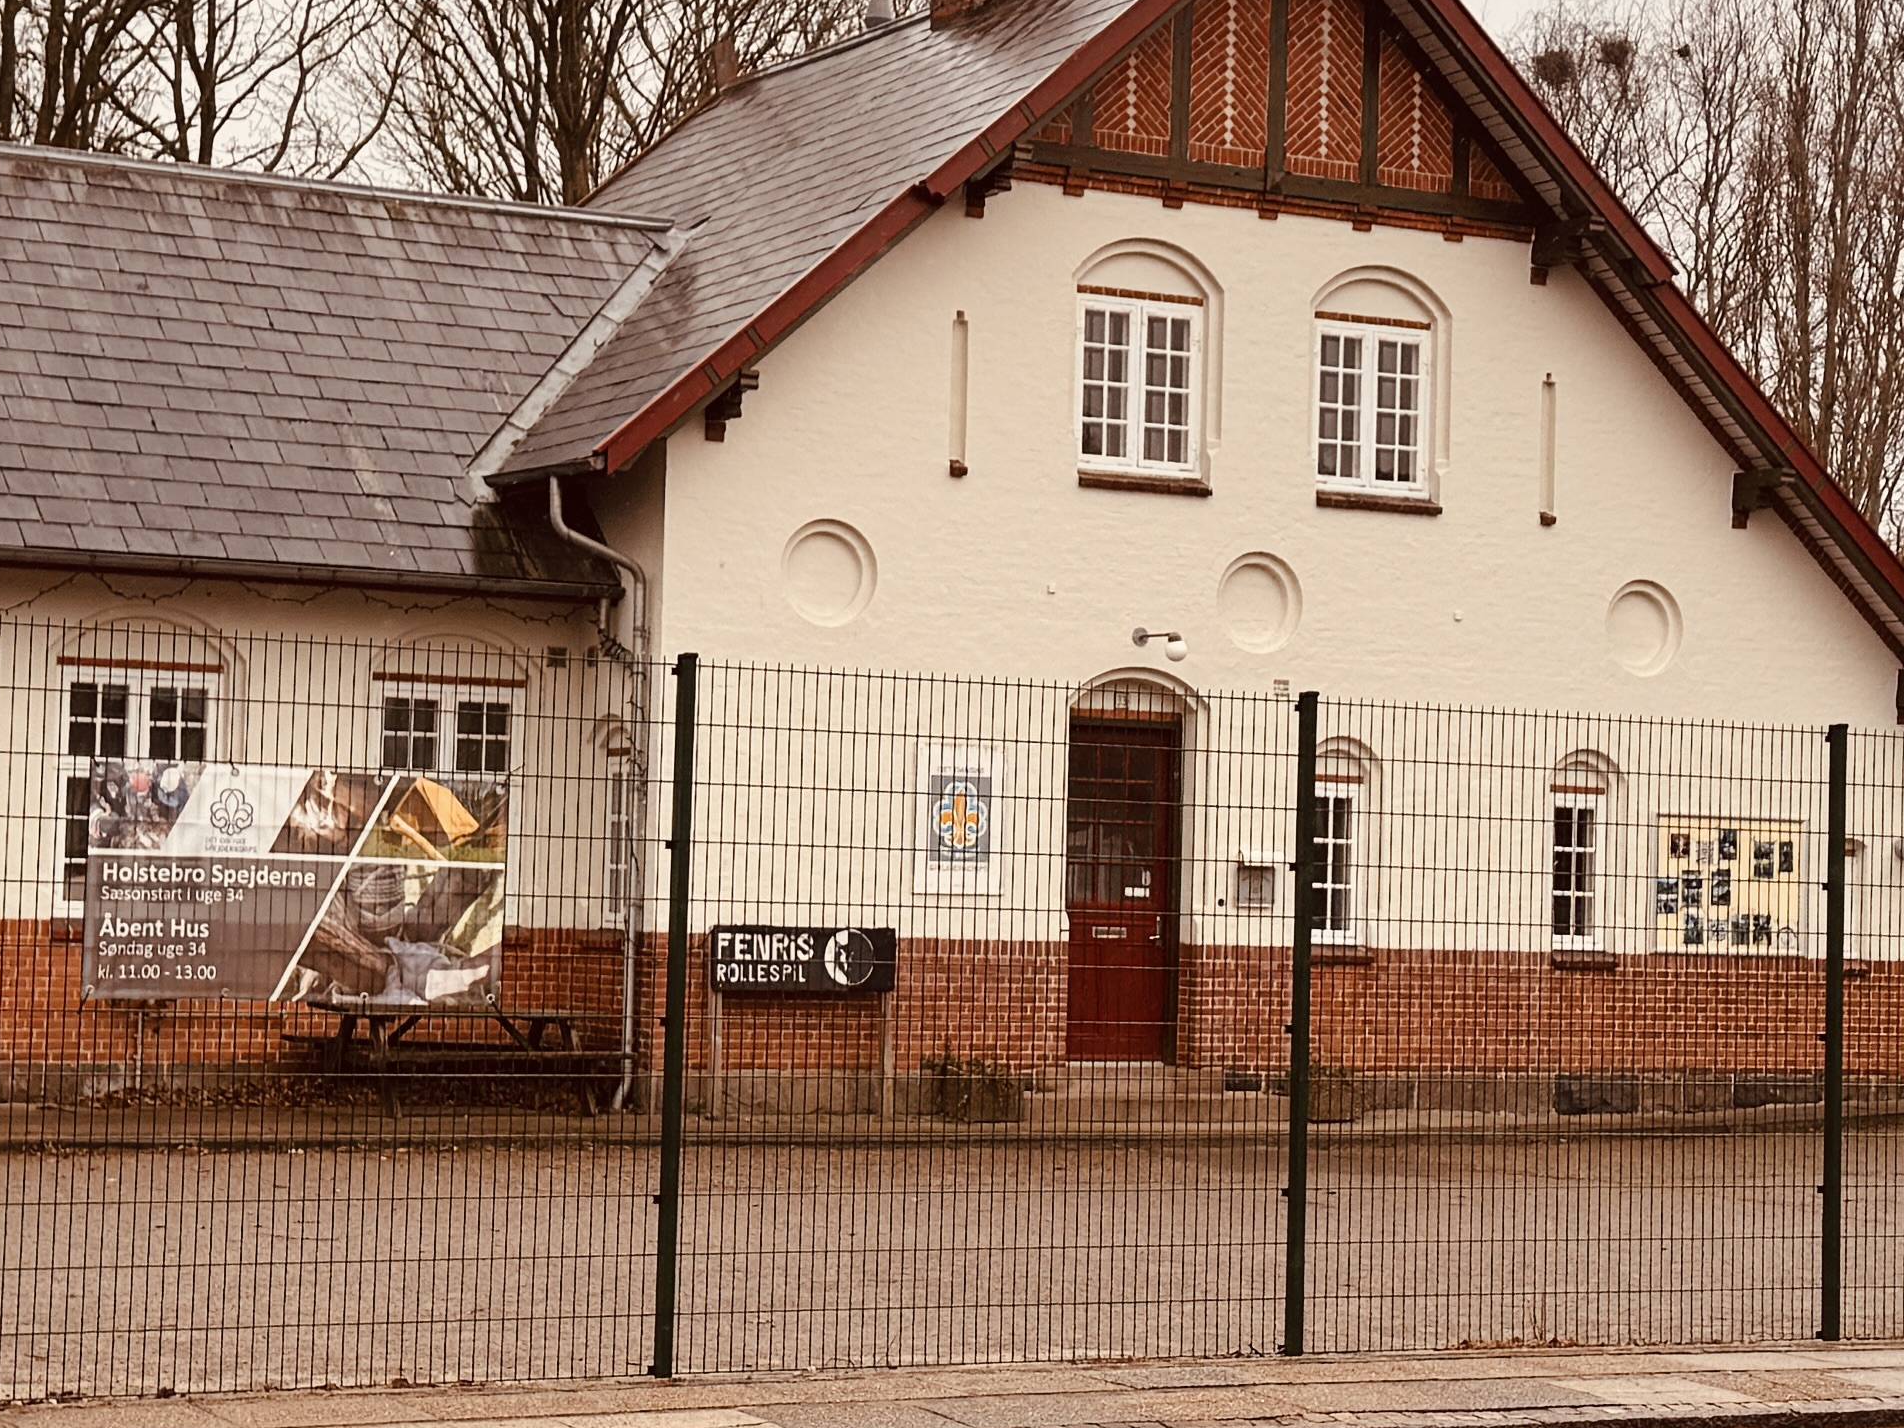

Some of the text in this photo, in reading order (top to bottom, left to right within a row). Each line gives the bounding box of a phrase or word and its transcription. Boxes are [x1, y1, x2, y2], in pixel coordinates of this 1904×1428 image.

[102, 862, 316, 888] Holstebro Spejderne
[101, 885, 182, 902] Sæsonstart
[195, 891, 222, 904] uge
[226, 888, 244, 902] 34
[99, 912, 210, 938] Åbent Hus
[98, 941, 206, 959] Søndag uge 34
[118, 964, 161, 979] 11.00
[175, 965, 217, 980] 13.00
